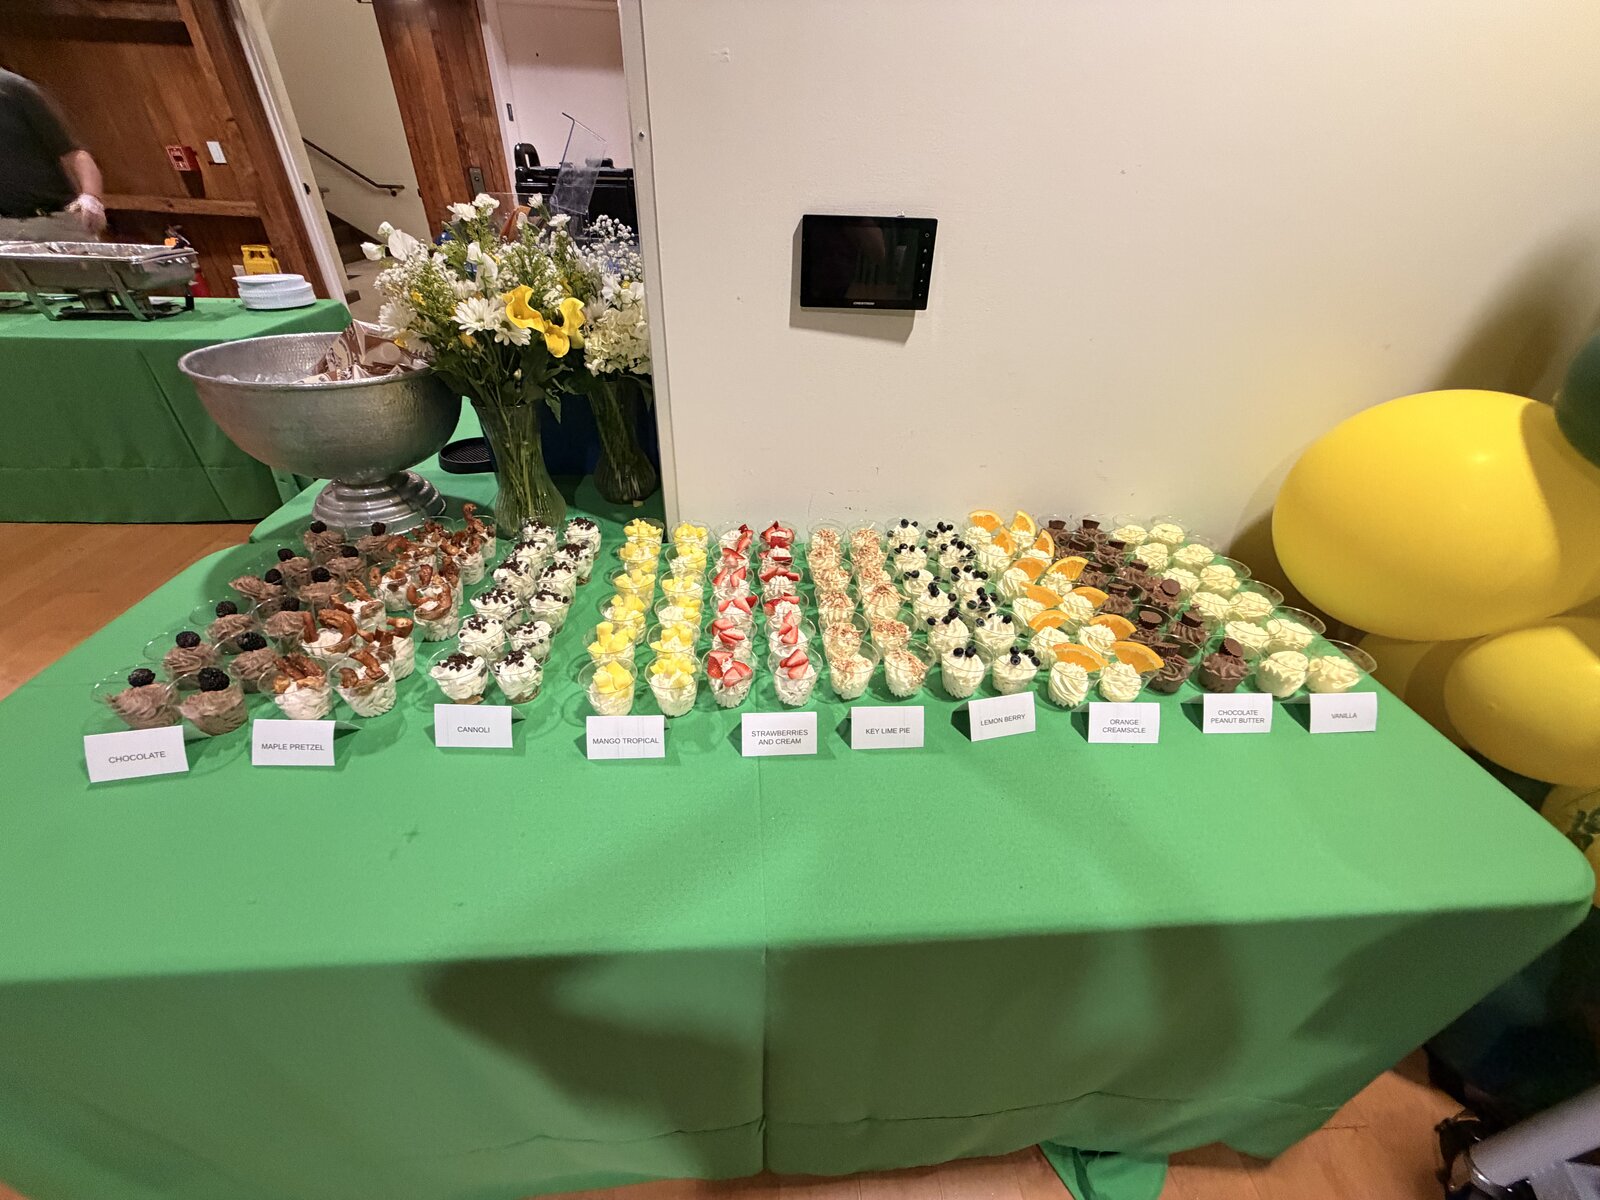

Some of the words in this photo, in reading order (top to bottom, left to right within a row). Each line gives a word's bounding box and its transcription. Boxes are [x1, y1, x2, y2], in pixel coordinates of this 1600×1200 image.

[980, 717, 1003, 726] LEMON
[1004, 714, 1026, 723] BERRY
[1110, 718, 1139, 726] ORANGE
[457, 726, 490, 734] CANNOLI
[751, 729, 809, 738] STRAWBERRIES
[881, 727, 897, 735] LIME
[1102, 726, 1146, 734] CREAMSICLE
[592, 737, 621, 745] MANGO
[622, 737, 659, 745] TROPICAL
[758, 738, 774, 746] AND
[289, 743, 325, 751] PRETZEL
[108, 750, 167, 764] CHOCOLATE
